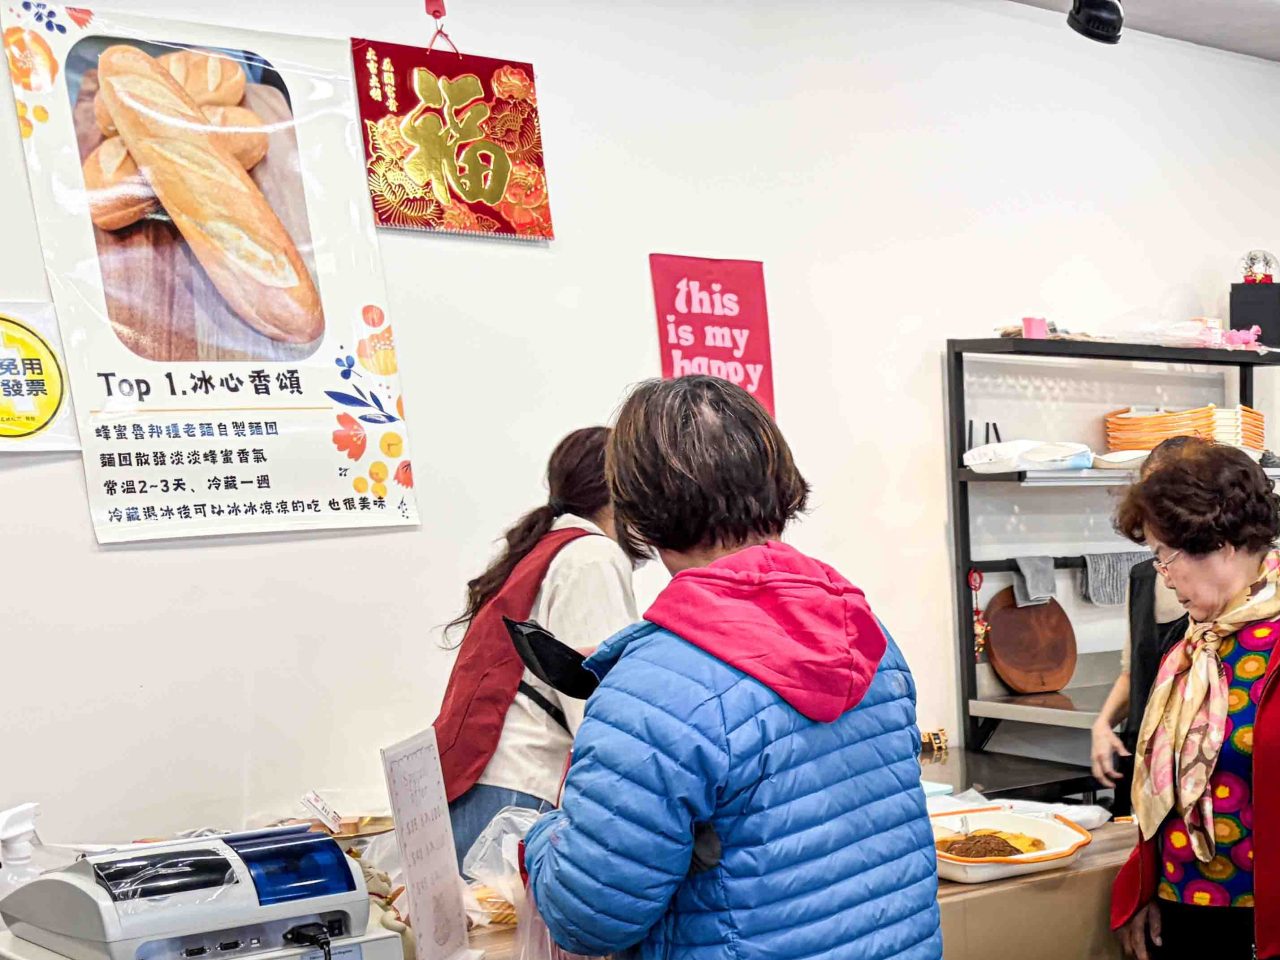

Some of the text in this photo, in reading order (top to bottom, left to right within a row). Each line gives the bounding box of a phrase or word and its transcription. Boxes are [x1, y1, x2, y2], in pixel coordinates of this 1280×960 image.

[400, 66, 512, 206] 福
[674, 277, 740, 317] this
[666, 314, 750, 358] is my
[0, 358, 43, 376] 免用
[1, 379, 48, 397] 發票
[97, 372, 151, 402] Top
[328, 496, 387, 511] 也很美味
